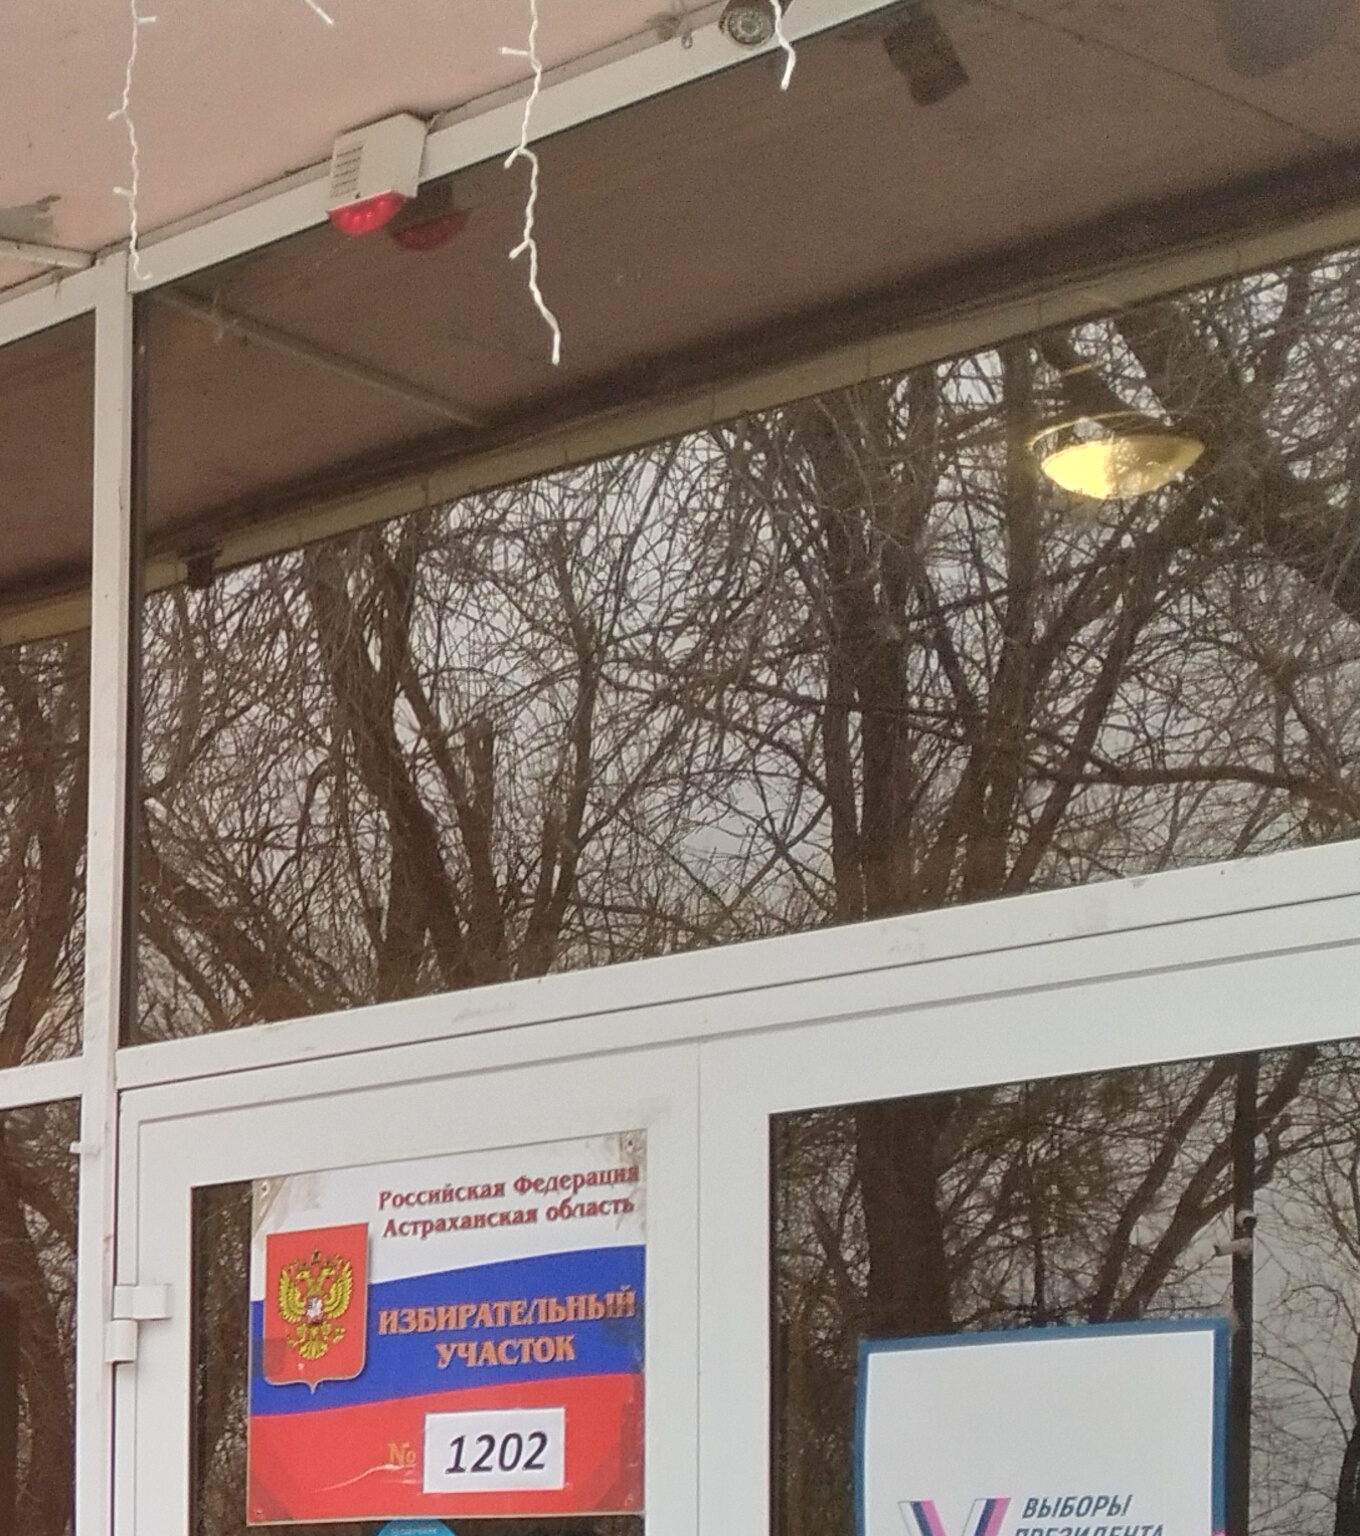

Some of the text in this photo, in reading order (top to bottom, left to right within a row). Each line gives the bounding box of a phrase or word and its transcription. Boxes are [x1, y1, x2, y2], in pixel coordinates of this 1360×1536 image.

[379, 1164, 639, 1211] Российская Федерация
[382, 1196, 635, 1238] Астраханская область
[378, 1284, 637, 1336] ИЗБИРАТЕЛЬНЫЙ
[434, 1335, 576, 1369] УЧАСТОК
[445, 1431, 549, 1475] 1202
[1022, 1494, 1133, 1519] ВЫБОРЫ
